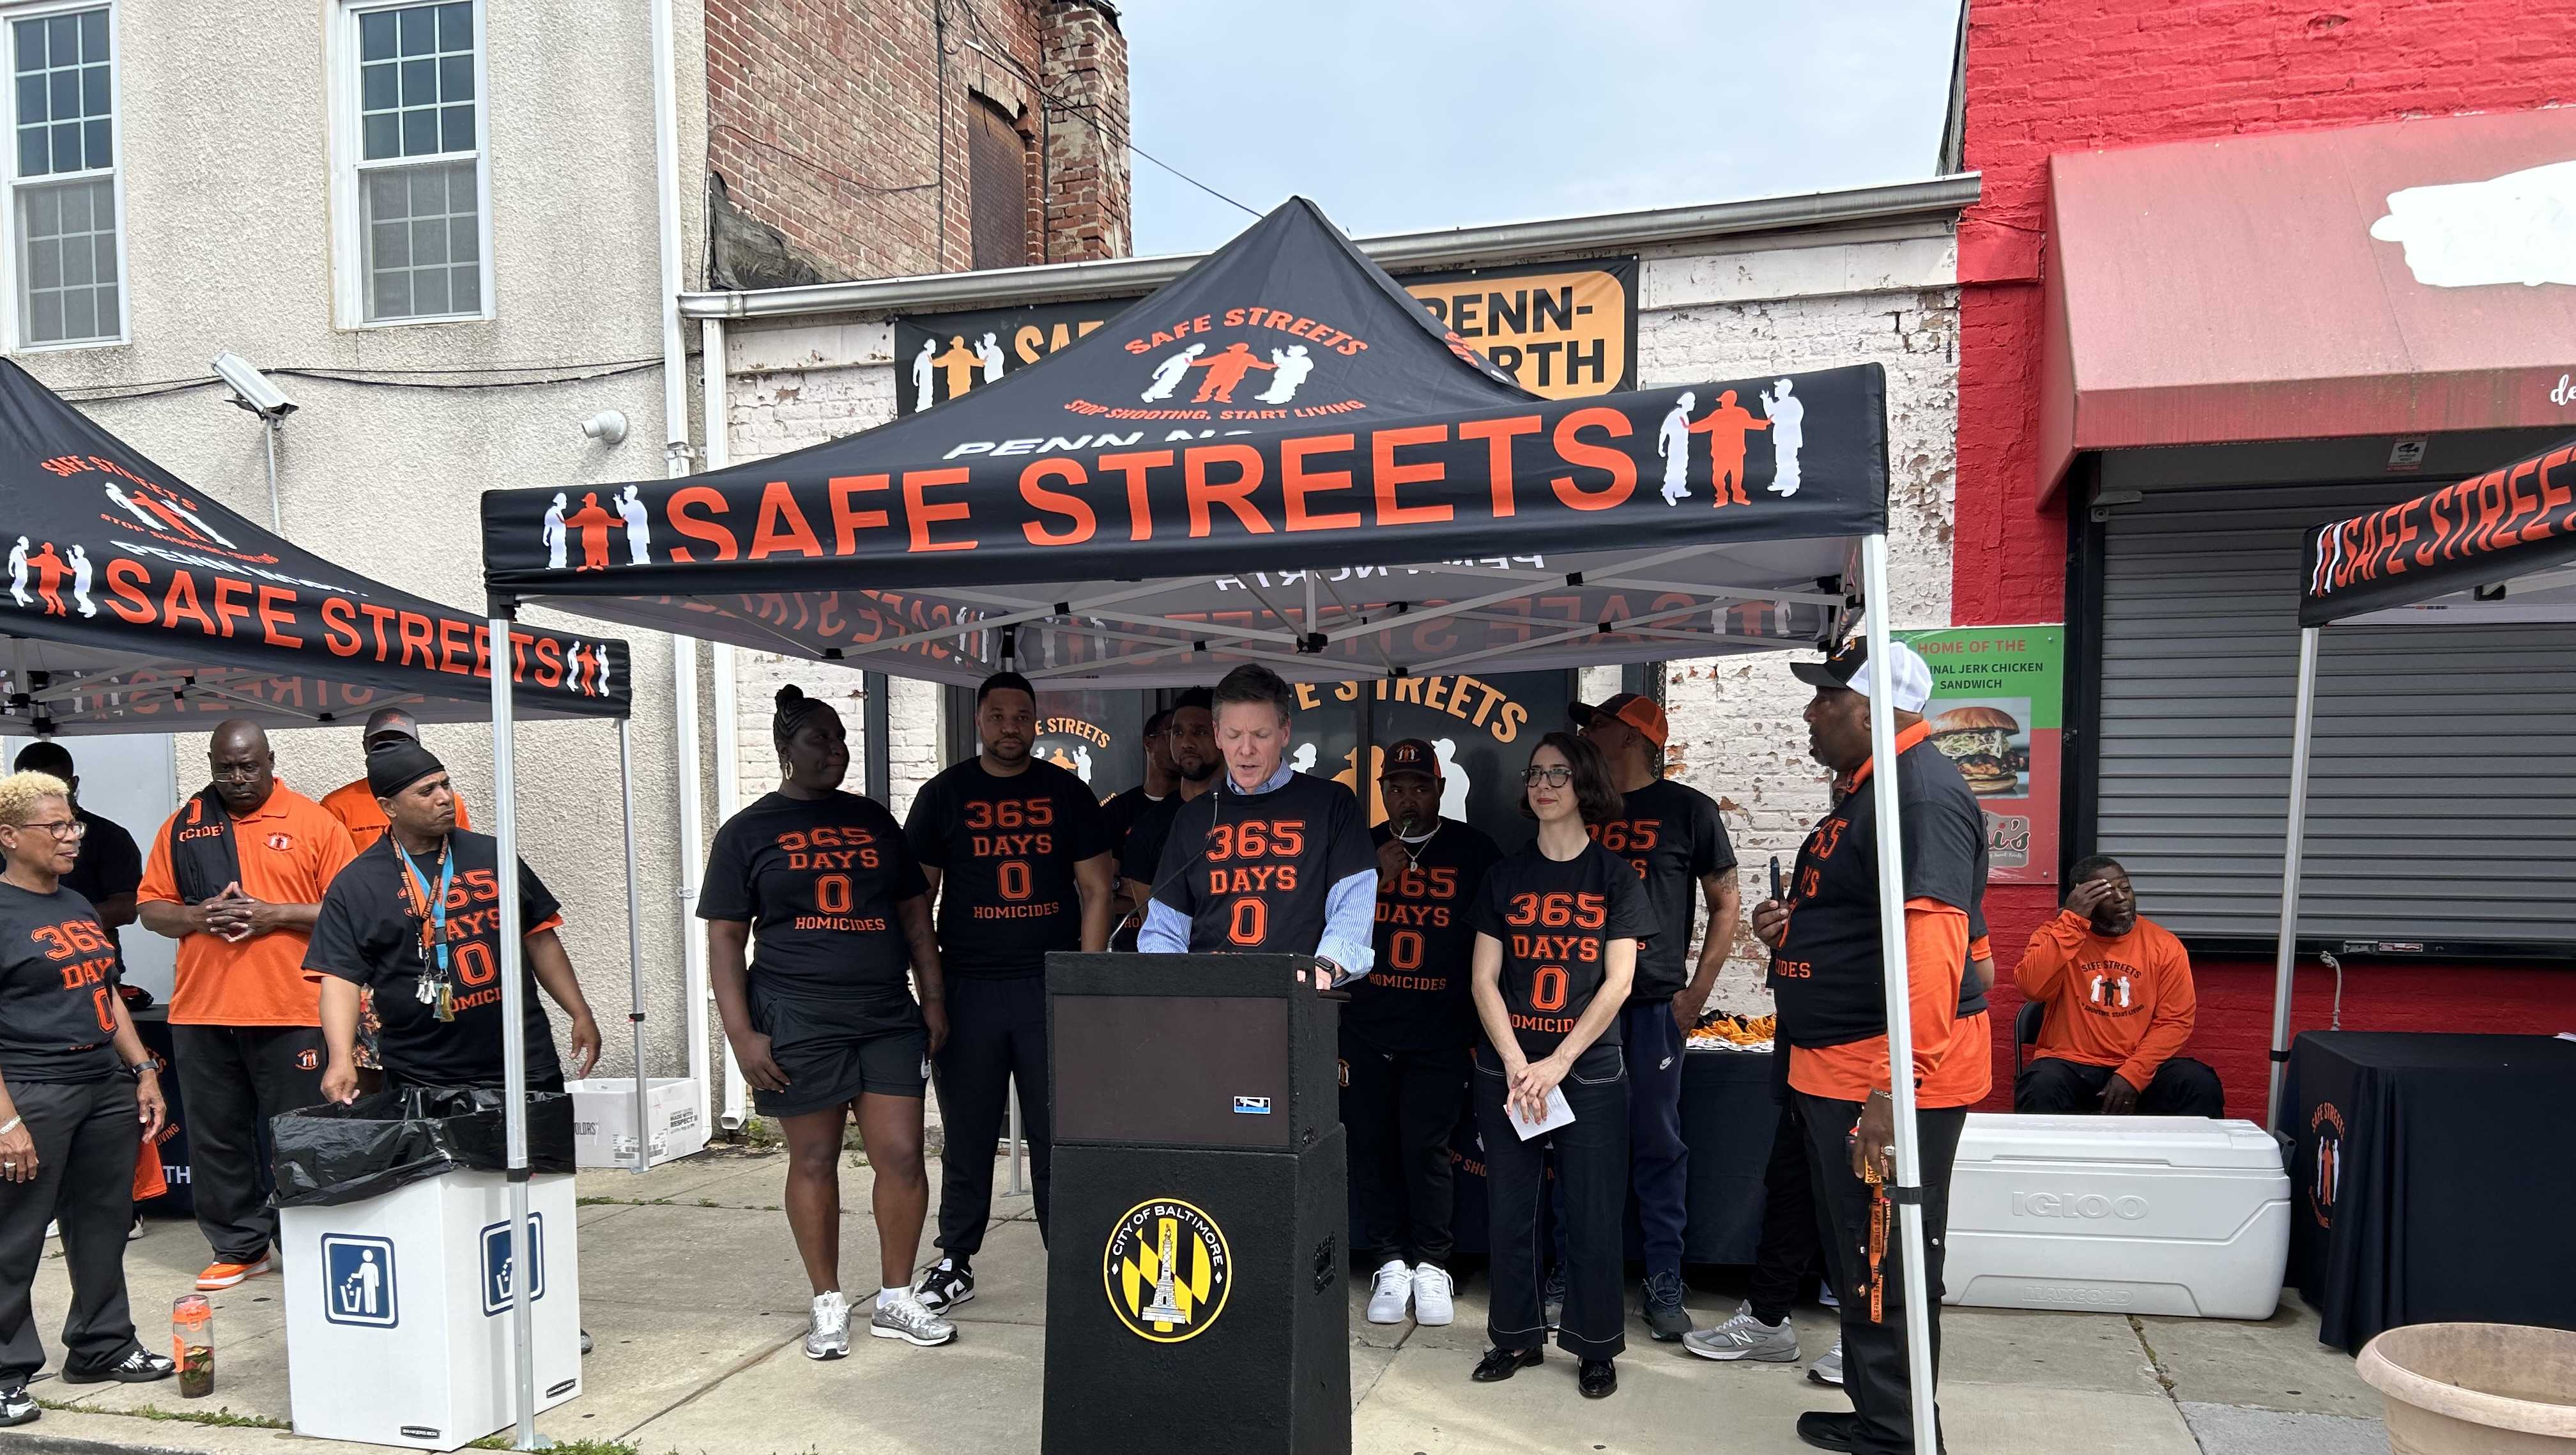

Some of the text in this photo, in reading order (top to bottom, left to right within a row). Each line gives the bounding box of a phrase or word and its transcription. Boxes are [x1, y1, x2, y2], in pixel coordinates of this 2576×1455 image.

[1124, 306, 1370, 357] SAFE STREETS
[1489, 338, 1606, 387] RTH
[1064, 399, 1367, 421] STOP SHOOTING, START LIVING
[942, 431, 1144, 460] PENN
[41, 454, 198, 511] SAFE STREETS
[666, 406, 1638, 563] SAFE STREETS
[2335, 445, 2576, 588] SAFE STREE
[105, 557, 304, 649] SAFE
[321, 597, 561, 690] STREETS
[1917, 639, 2026, 655] HOME OF THE
[1929, 662, 2044, 675] INAL JERK CHICKEN
[1939, 679, 2003, 691] SANDWICH
[1046, 717, 1111, 748] STREETS
[965, 796, 1055, 829] 365
[972, 832, 1054, 858] DAYS
[1204, 819, 1306, 863] 365
[788, 847, 880, 870] DAYS
[398, 868, 499, 916] 65
[814, 873, 854, 916] 0
[996, 859, 1034, 902] 0
[1209, 865, 1298, 895] DAYS
[445, 907, 500, 941] AYS
[793, 915, 886, 932] HOMICIDES
[972, 901, 1059, 920] HOMICIDES
[1227, 897, 1269, 947] 0
[1374, 902, 1451, 927] DAYS
[1505, 891, 1608, 930] 365
[31, 920, 116, 962] 365
[1388, 929, 1425, 972] 0
[1512, 935, 1600, 962] DAYS
[61, 956, 116, 990] DAY
[452, 940, 498, 988] 0
[2103, 960, 2142, 978] STREETS
[1369, 973, 1447, 991] HOMICIDES
[1529, 964, 1569, 1013] 0
[450, 987, 501, 1012] OMICI
[1508, 1013, 1579, 1033] OMICID
[574, 1122, 596, 1136] OLORS
[2012, 1190, 2150, 1220] IGLOO
[1112, 1205, 1223, 1267] CITY OF BALTIMORE
[2023, 1286, 2133, 1306] MAXCOLD
